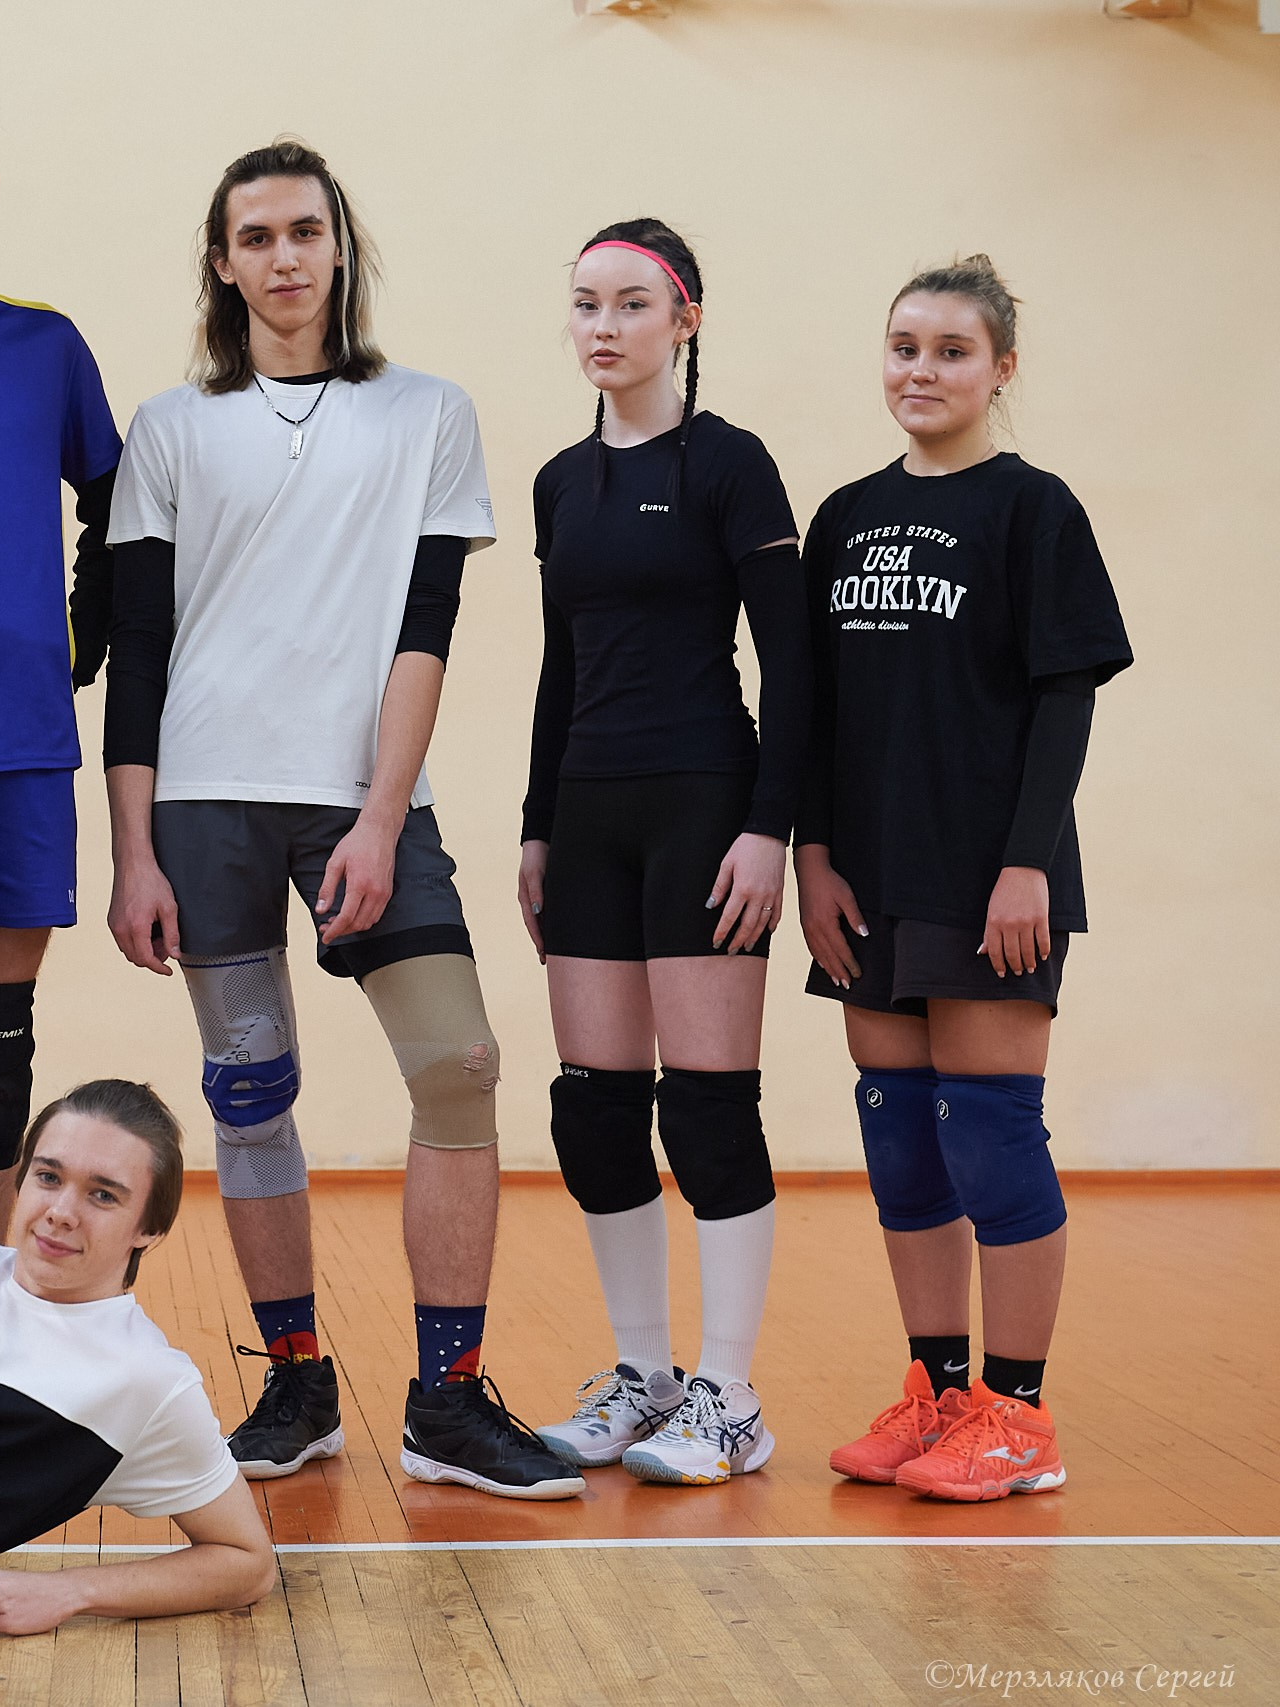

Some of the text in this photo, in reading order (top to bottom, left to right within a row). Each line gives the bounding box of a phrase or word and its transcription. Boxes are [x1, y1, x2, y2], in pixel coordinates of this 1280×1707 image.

[846, 525, 958, 549] UNITED STATES
[862, 545, 914, 572] USA
[830, 575, 968, 620] ROOKLYN
[841, 618, 876, 630] athletic
